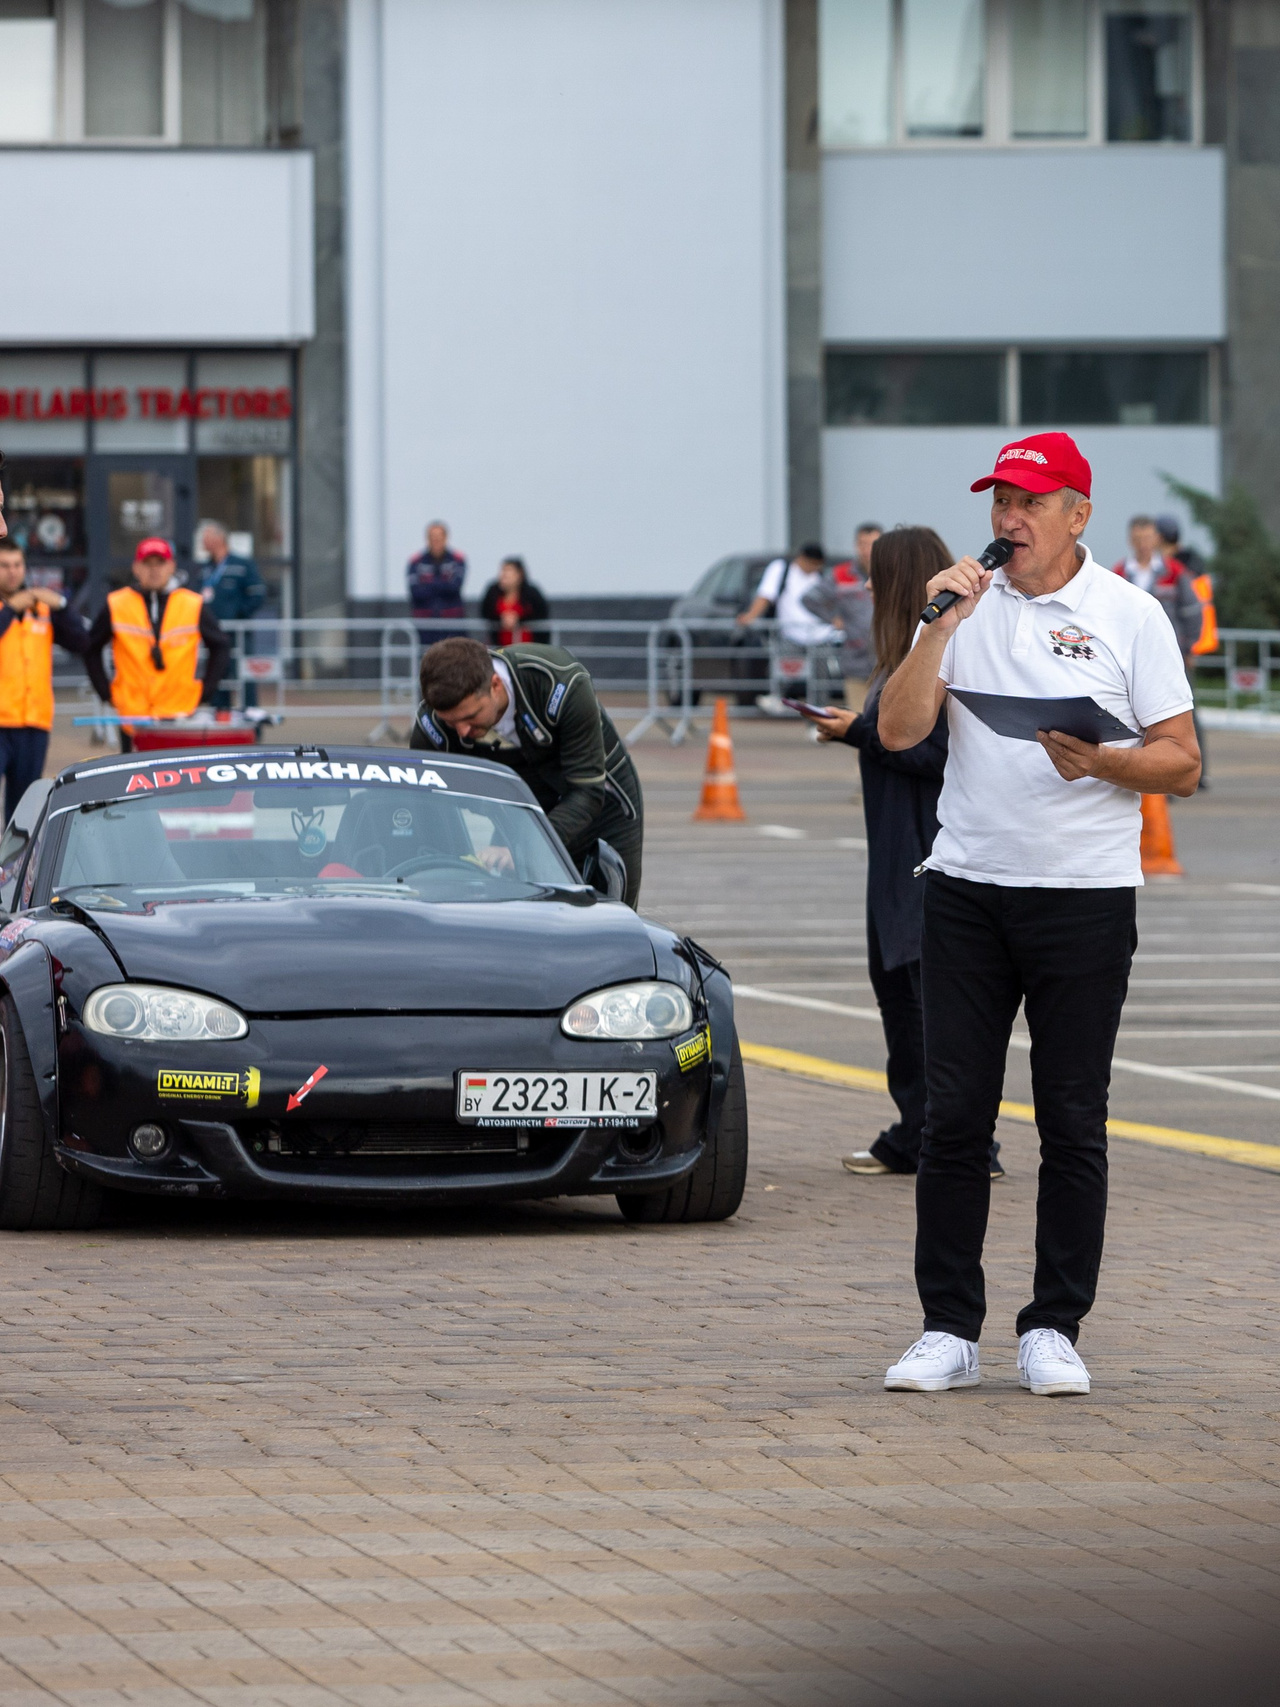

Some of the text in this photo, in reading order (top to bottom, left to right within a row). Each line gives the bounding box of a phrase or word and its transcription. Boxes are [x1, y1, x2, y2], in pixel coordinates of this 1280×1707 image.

[137, 386, 292, 420] TRACTORS
[464, 1098, 482, 1112] BY
[492, 1077, 569, 1112] 2323
[477, 1117, 542, 1128] Автозапчасти
